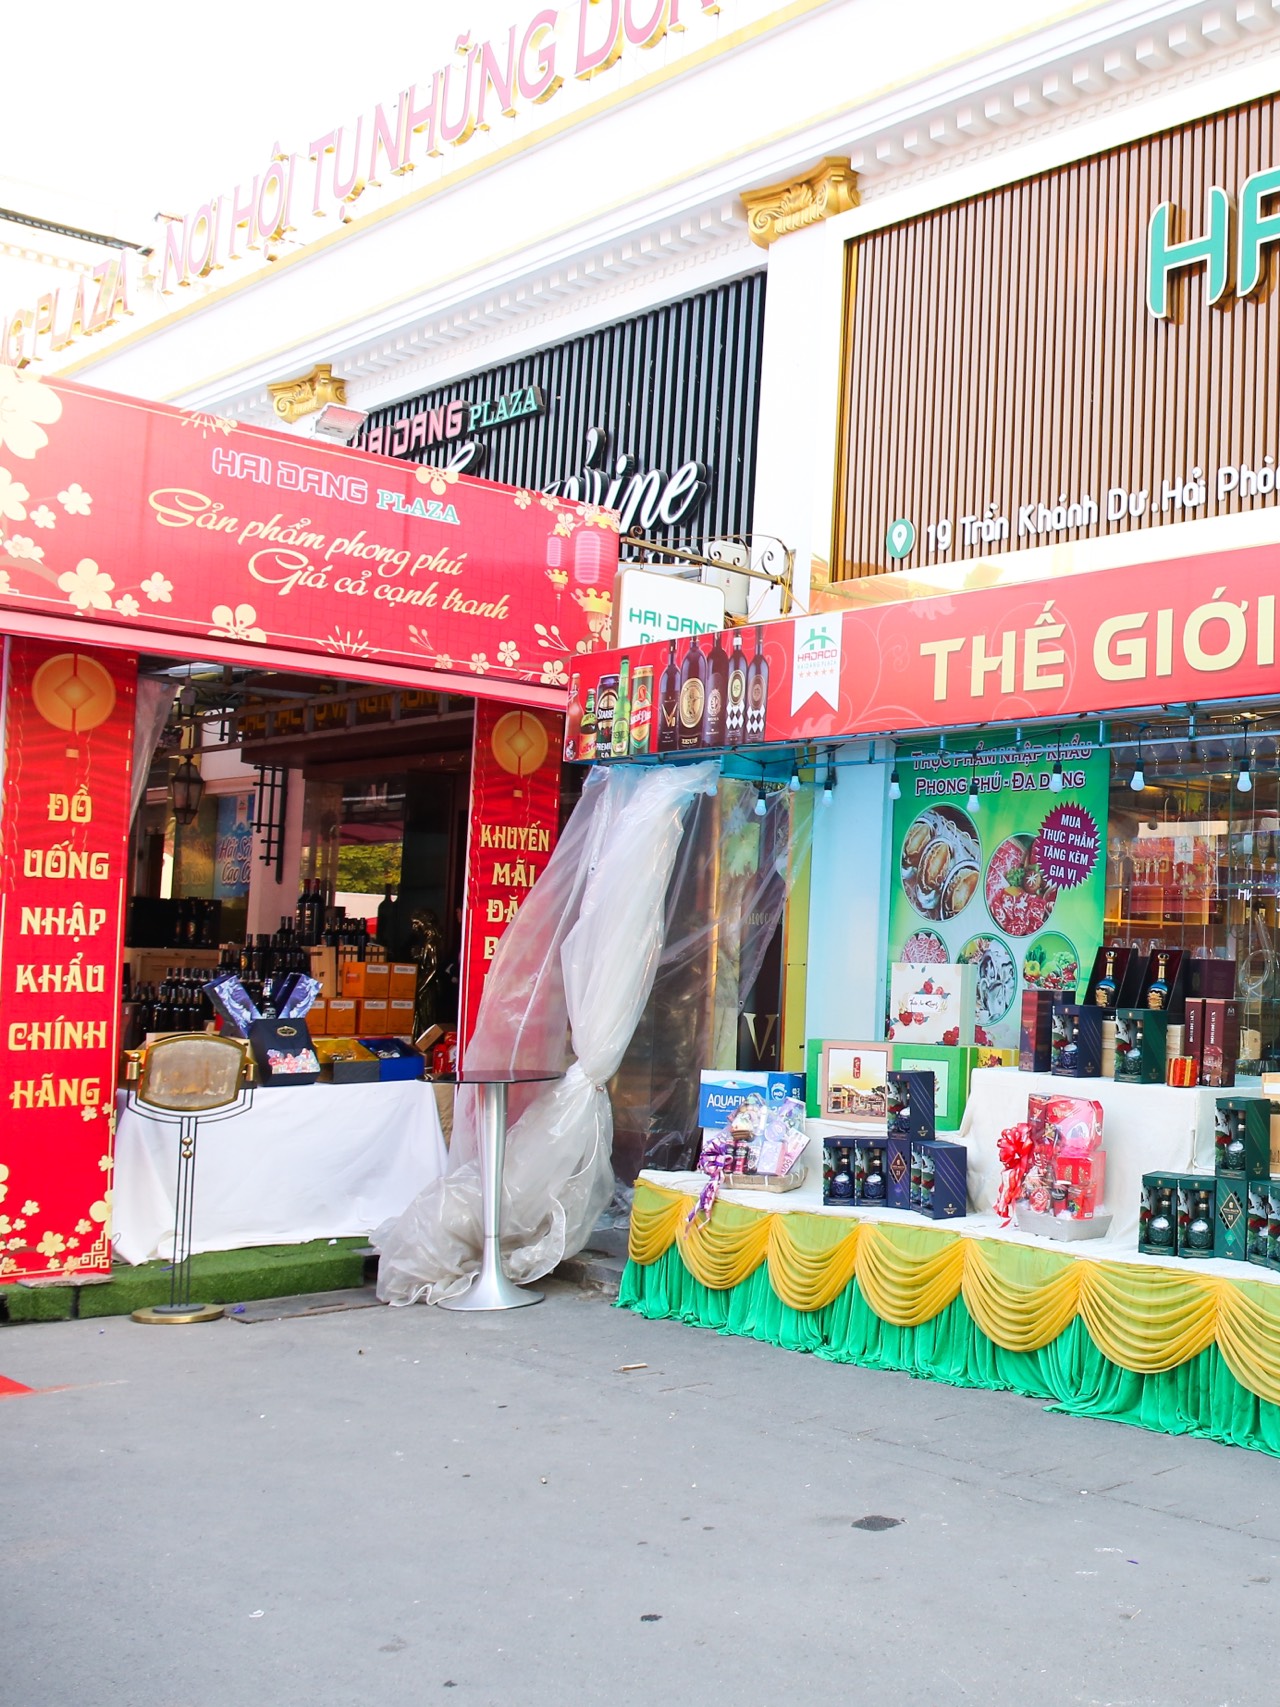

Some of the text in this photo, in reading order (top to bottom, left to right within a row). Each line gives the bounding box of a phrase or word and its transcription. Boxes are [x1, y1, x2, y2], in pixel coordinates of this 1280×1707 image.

[33, 247, 129, 352] PLAZA
[161, 196, 221, 290] NƠI
[229, 142, 297, 260] HỘI
[309, 115, 364, 222] TỤ
[368, 9, 559, 184] NHỮNG
[393, 400, 462, 456] DANG
[468, 387, 538, 431] PLAZA
[212, 447, 461, 525] HAI DANG PLAZA
[147, 487, 465, 579] Sản phẩm phong phú
[927, 519, 952, 552] 19
[960, 504, 1009, 547] Trần
[1018, 494, 1098, 538] Khánh
[248, 546, 510, 621] Giá cả cạnh tranh
[629, 607, 718, 636] HAI DANG
[798, 649, 837, 662] HADACO
[920, 601, 1066, 701] THẾ
[1093, 587, 1275, 682] GIỚI
[916, 777, 967, 796] PHONG
[1012, 772, 1035, 791] ĐA
[47, 785, 92, 823] ĐỒ
[1061, 813, 1081, 829] MUA
[481, 821, 550, 852] KHUYẾN
[1043, 827, 1094, 849] THỰC PHẨM
[1043, 845, 1088, 866] TẶNG KÈM
[23, 838, 110, 880] UỐNG
[1050, 864, 1077, 883] GIA VỊ
[20, 901, 106, 942] NHẬP
[16, 952, 104, 993] KHẨU
[8, 1016, 107, 1051] CHÍNH
[12, 1077, 101, 1109] HÃNG
